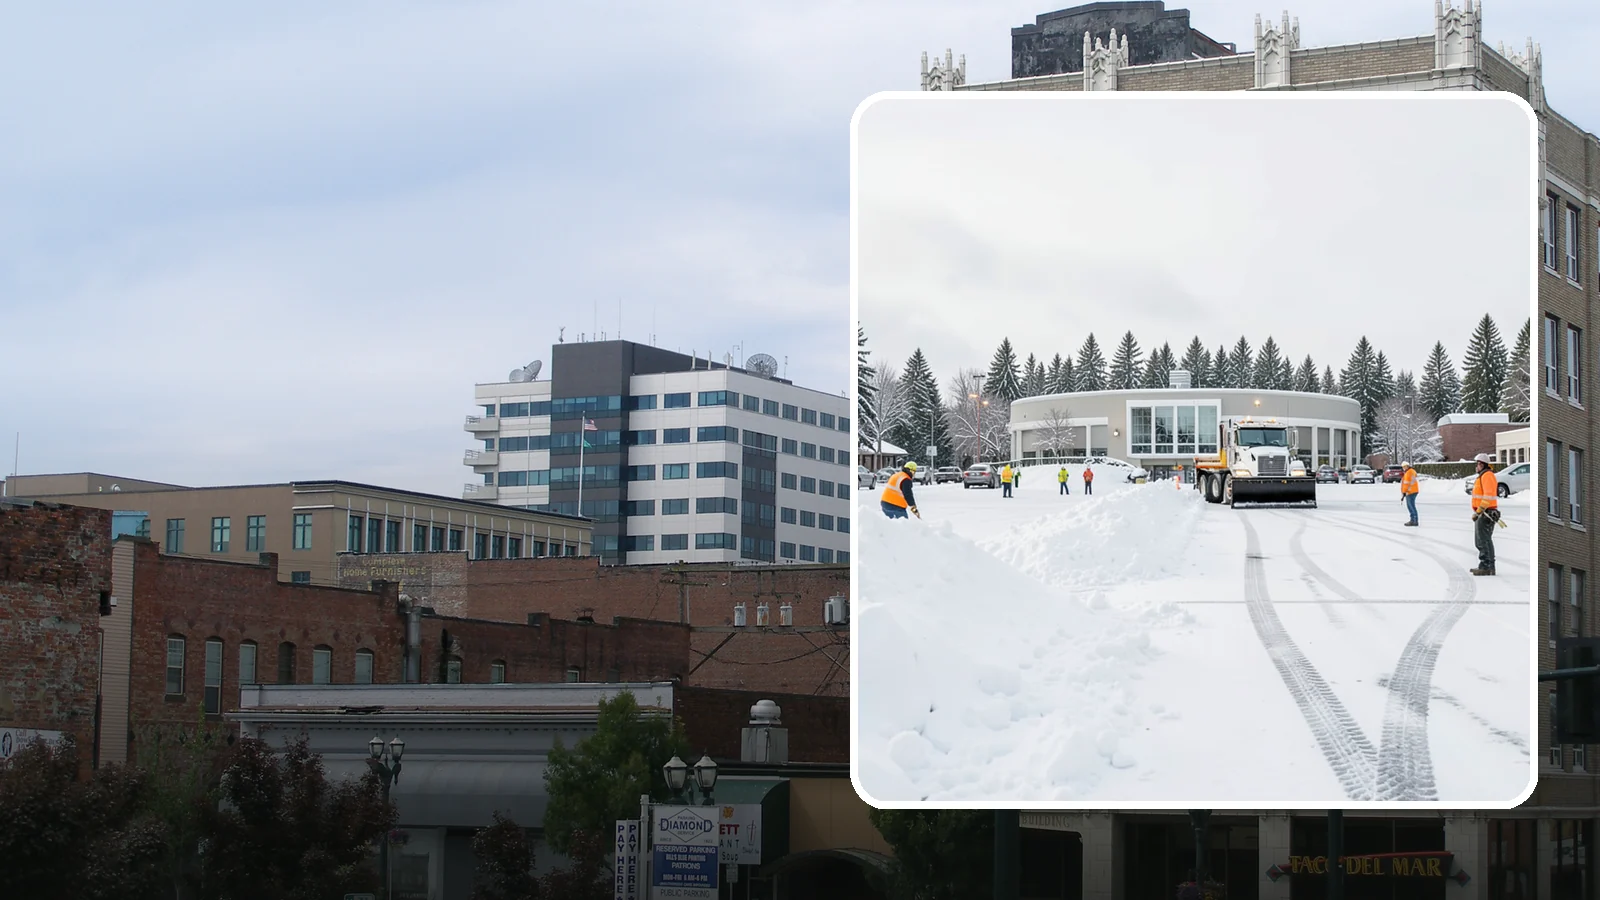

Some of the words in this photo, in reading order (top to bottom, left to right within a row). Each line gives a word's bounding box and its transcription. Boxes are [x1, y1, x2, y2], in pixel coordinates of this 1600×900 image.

[370, 566, 427, 577] Furnishers
[660, 818, 713, 833] DIAMOND
[1022, 815, 1070, 828] BUILDING
[617, 824, 625, 853] PAY
[628, 824, 636, 853] PAY
[655, 845, 688, 853] RESERVED
[689, 846, 716, 854] PARKING
[721, 851, 739, 862] Soup
[671, 862, 701, 870] PATRONS
[1345, 856, 1386, 876] DEL
[1392, 857, 1443, 877] MAR
[616, 855, 625, 894] HERE
[627, 855, 636, 893] HERE
[660, 889, 682, 897] PUBLIC
[683, 889, 710, 898] PARKING
